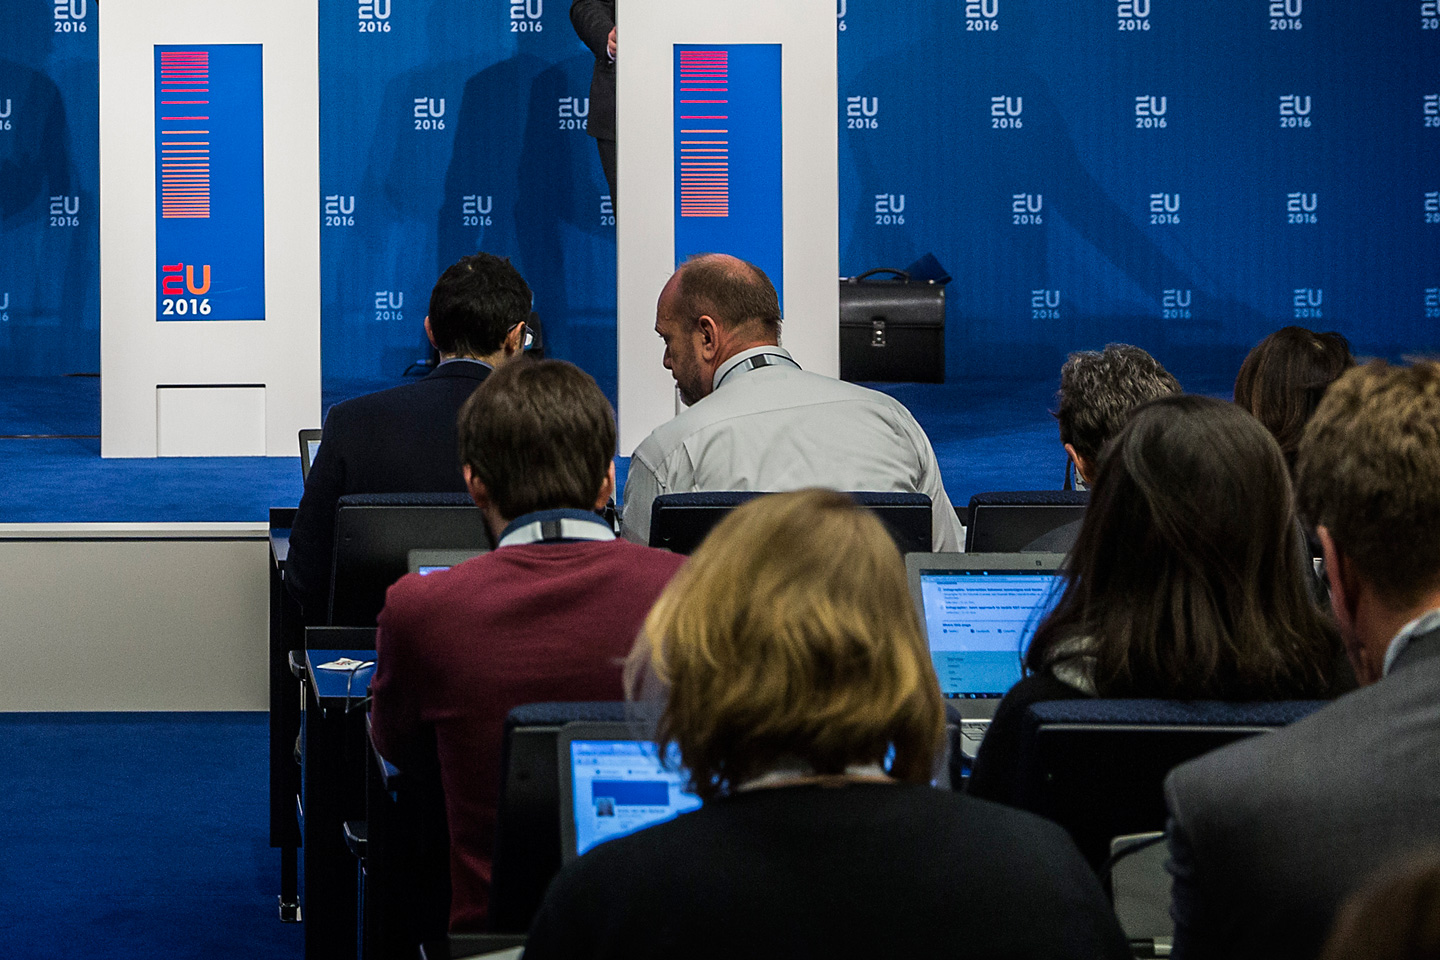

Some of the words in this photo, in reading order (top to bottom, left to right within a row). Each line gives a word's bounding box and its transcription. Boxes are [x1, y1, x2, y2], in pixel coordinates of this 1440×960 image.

[54, 21, 87, 33] 2016
[358, 20, 392, 33] 2016
[509, 20, 543, 33] 2016
[965, 19, 999, 32] 2016
[1117, 19, 1151, 31] 2016
[1269, 18, 1303, 31] 2016
[414, 119, 446, 131] 2016
[558, 118, 588, 130] 2016
[847, 117, 879, 130] 2016
[991, 117, 1023, 129] 2016
[1135, 117, 1168, 129] 2016
[1279, 116, 1312, 128] 2016
[462, 215, 493, 227] 2016
[1150, 213, 1181, 225] 2016
[162, 262, 211, 296] EU
[162, 298, 212, 315] 2016
